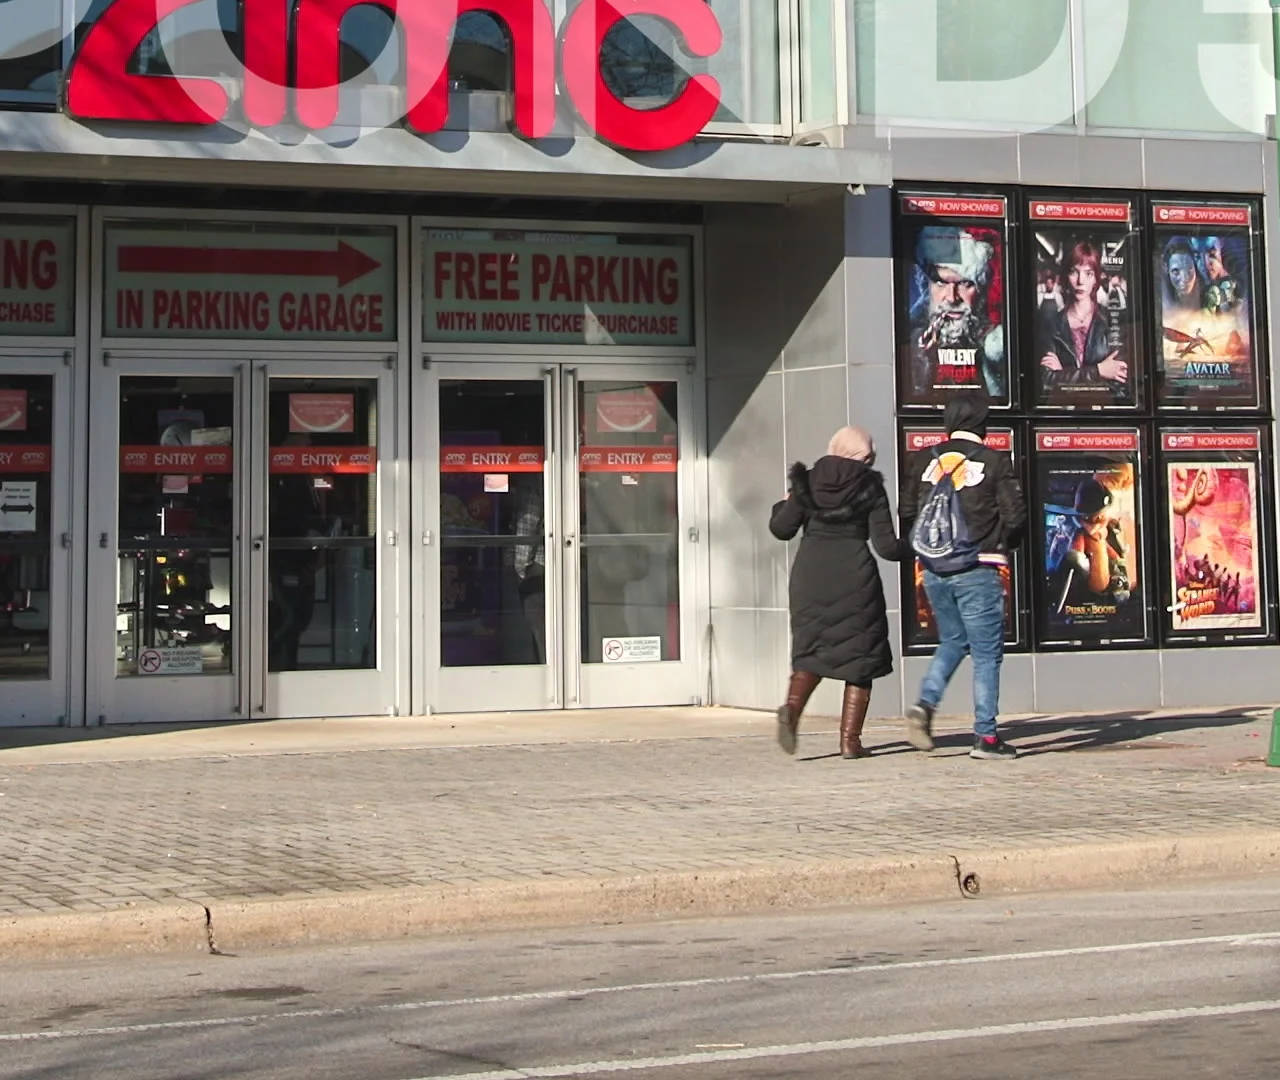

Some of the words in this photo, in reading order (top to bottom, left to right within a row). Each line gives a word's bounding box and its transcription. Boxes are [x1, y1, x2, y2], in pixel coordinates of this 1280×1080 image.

[940, 202, 960, 211] NOW
[960, 203, 999, 212] SHOWING
[1066, 207, 1087, 216] NOW
[1087, 208, 1124, 216] SHOWING
[1189, 211, 1208, 219] NOW
[1209, 211, 1244, 220] SHOWING
[1101, 256, 1124, 265] MENU
[433, 251, 520, 301] FREE
[532, 254, 679, 305] PARKING
[116, 289, 144, 329] IN
[153, 290, 270, 331] PARKING
[278, 292, 384, 333] GARAGE
[436, 311, 476, 332] WITH
[482, 313, 531, 332] MOVIE
[597, 314, 678, 334] PURCHASE
[937, 348, 978, 365] VIOLENT
[1186, 361, 1231, 375] AVATAR
[1074, 437, 1095, 445] NOW
[1095, 437, 1132, 446] SHOWING
[1197, 437, 1217, 445] NOW
[1217, 437, 1253, 446] SHOWING
[154, 453, 197, 465] ENTRY
[302, 454, 342, 466] ENTRY
[472, 453, 511, 465] ENTRY
[608, 453, 645, 465] ENTRY
[1180, 601, 1215, 623] WORLD
